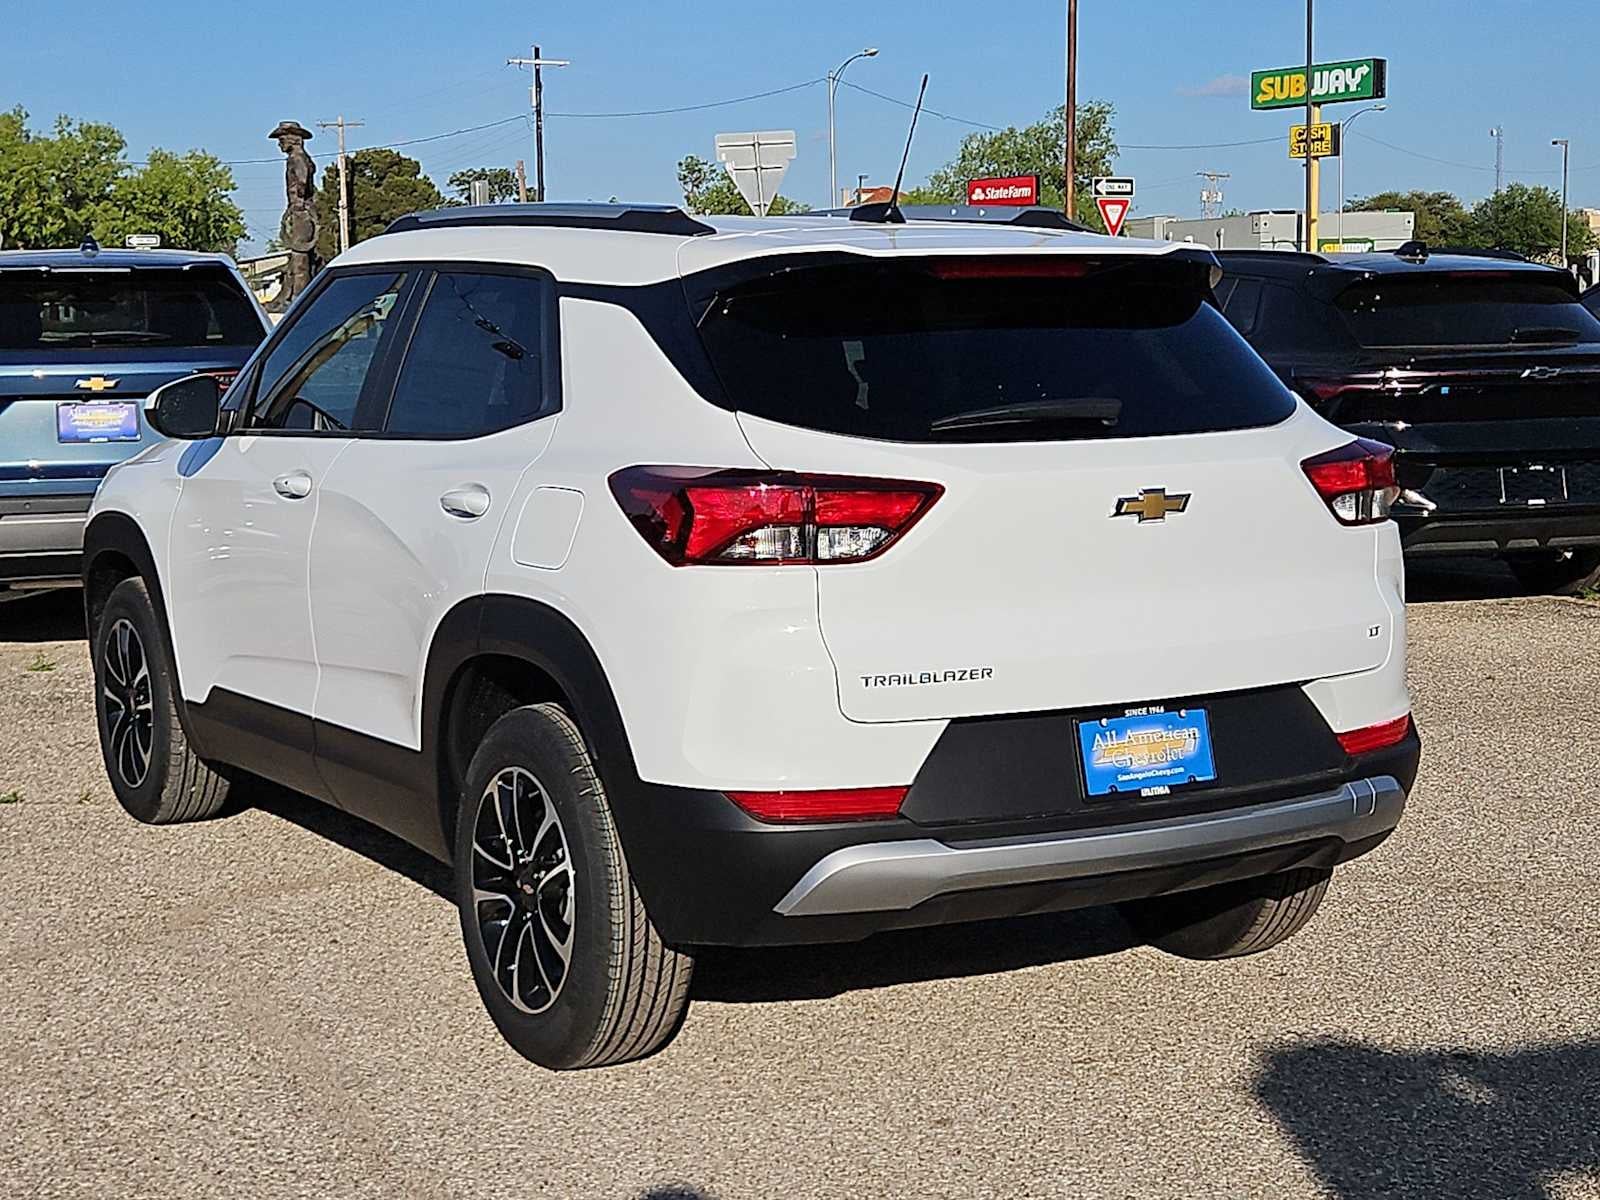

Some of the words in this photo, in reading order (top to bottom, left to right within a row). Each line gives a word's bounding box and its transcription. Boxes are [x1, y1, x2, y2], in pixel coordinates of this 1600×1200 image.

[1256, 64, 1370, 103] SUBWAY
[1296, 128, 1326, 141] CASH
[1292, 141, 1330, 154] STORE
[860, 668, 993, 687] TRAILBLAZER
[1124, 707, 1148, 717] SINCE
[1092, 729, 1117, 751] All
[1124, 725, 1200, 746] American
